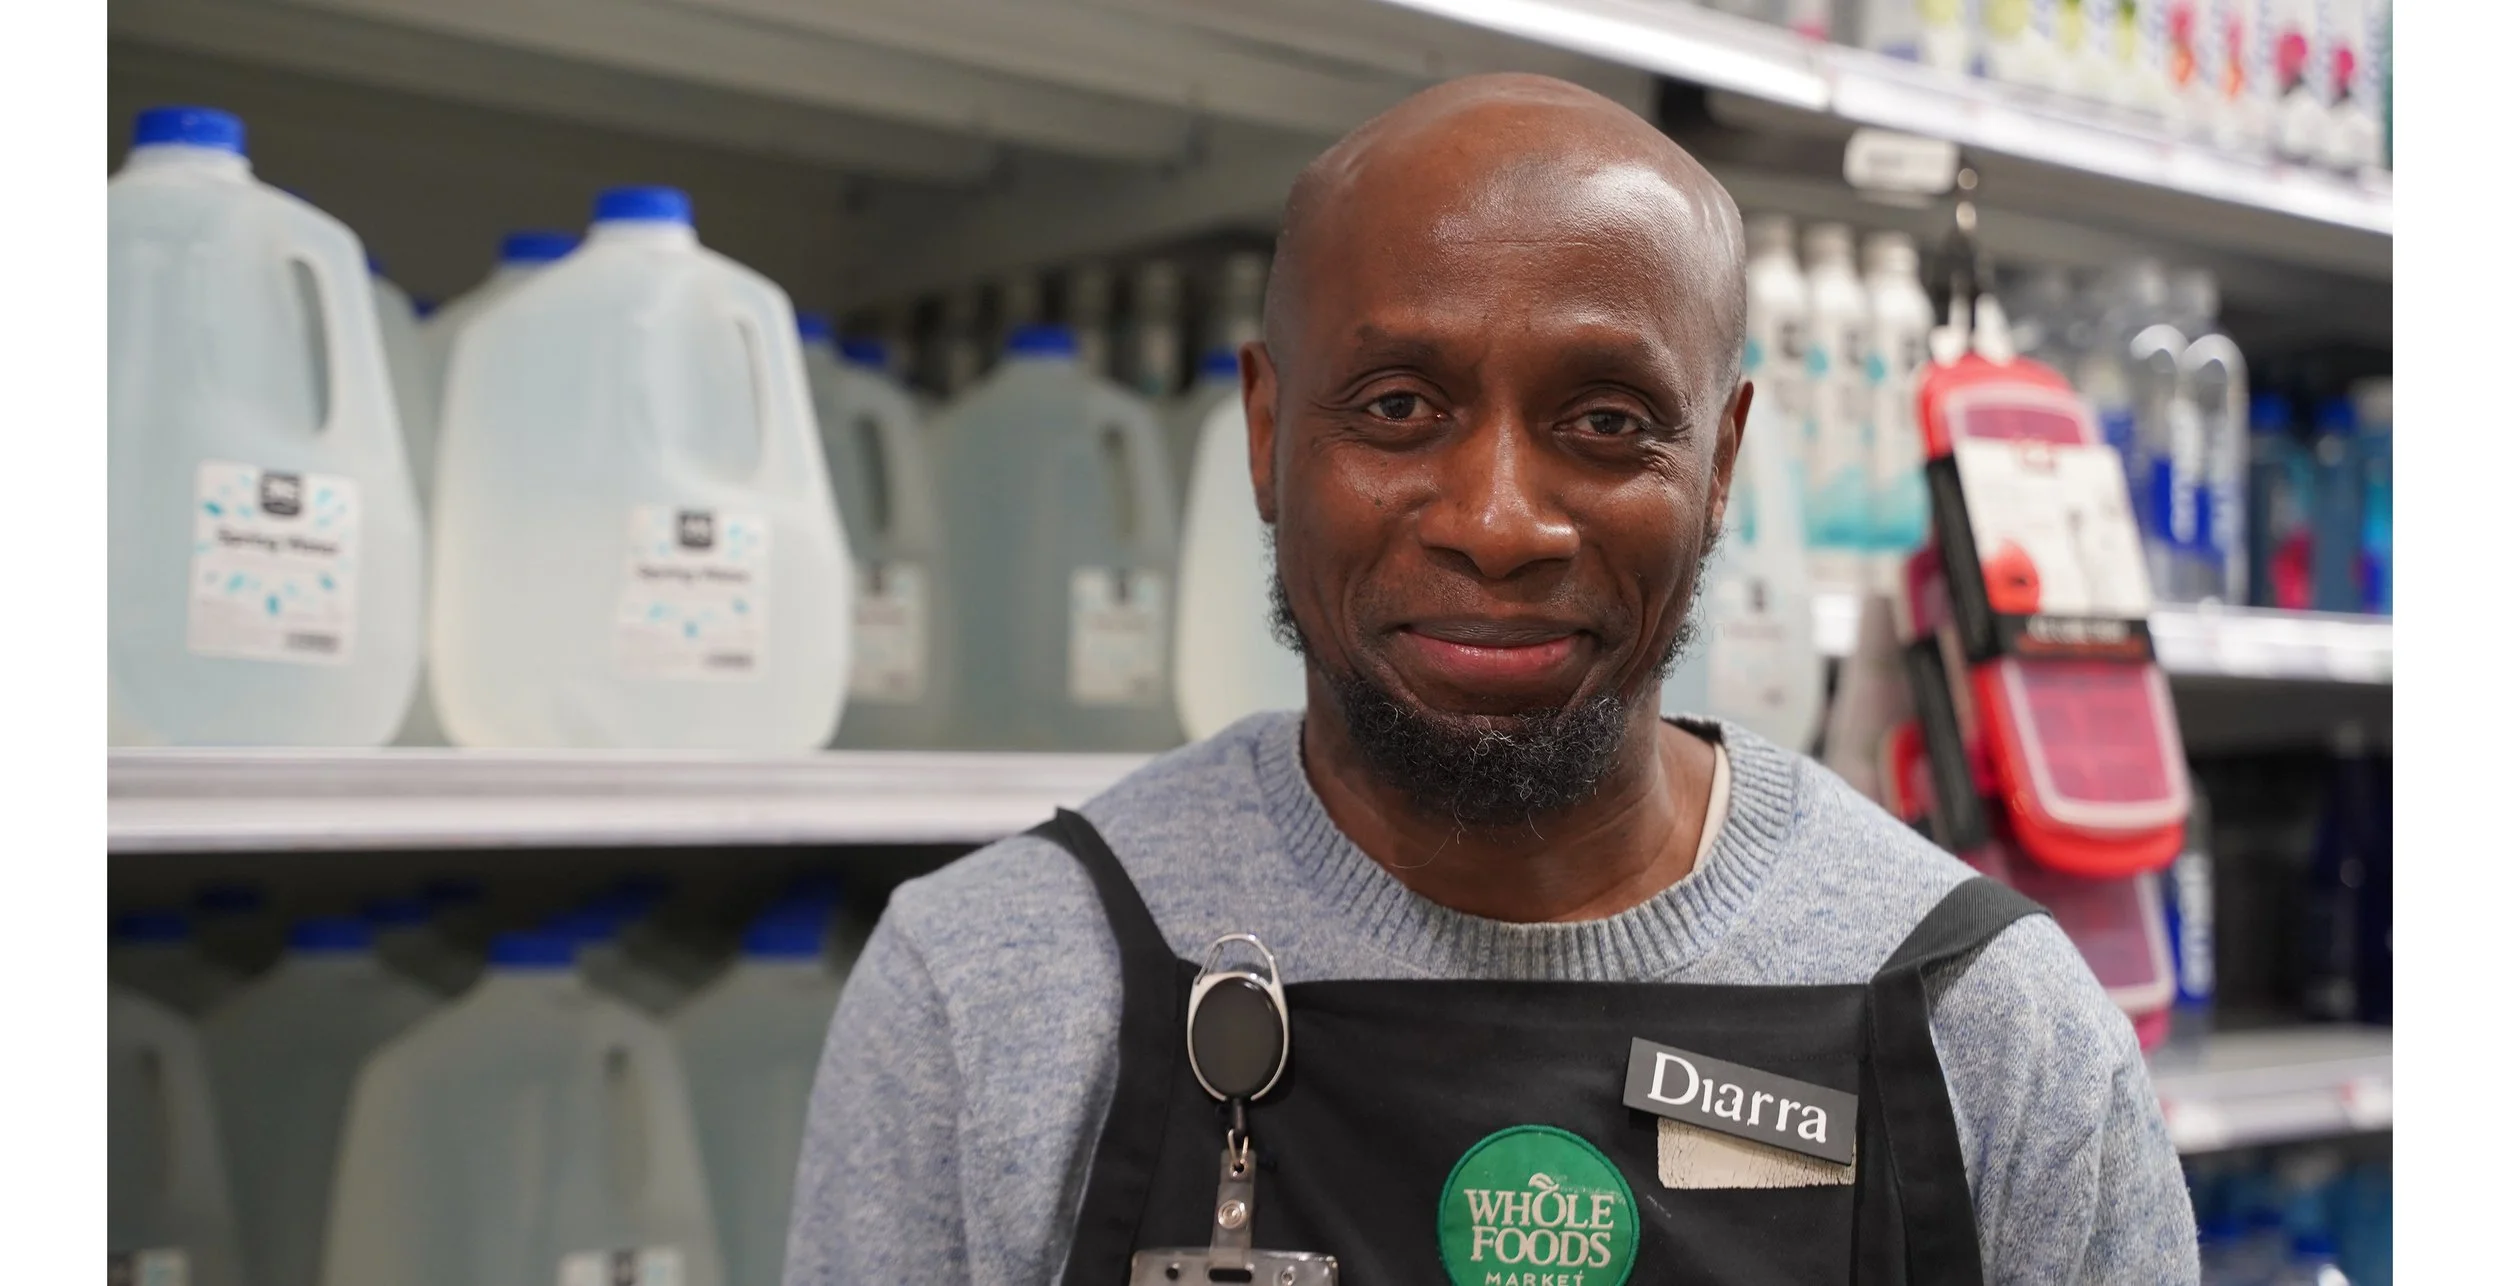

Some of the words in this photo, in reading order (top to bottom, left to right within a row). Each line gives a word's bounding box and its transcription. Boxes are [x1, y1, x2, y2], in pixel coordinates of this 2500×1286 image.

[1647, 1051, 1827, 1144] Diarra
[1463, 1187, 1615, 1231] WHOLE
[1470, 1225, 1612, 1269] FOODS
[1485, 1271, 1585, 1286] MARKET
